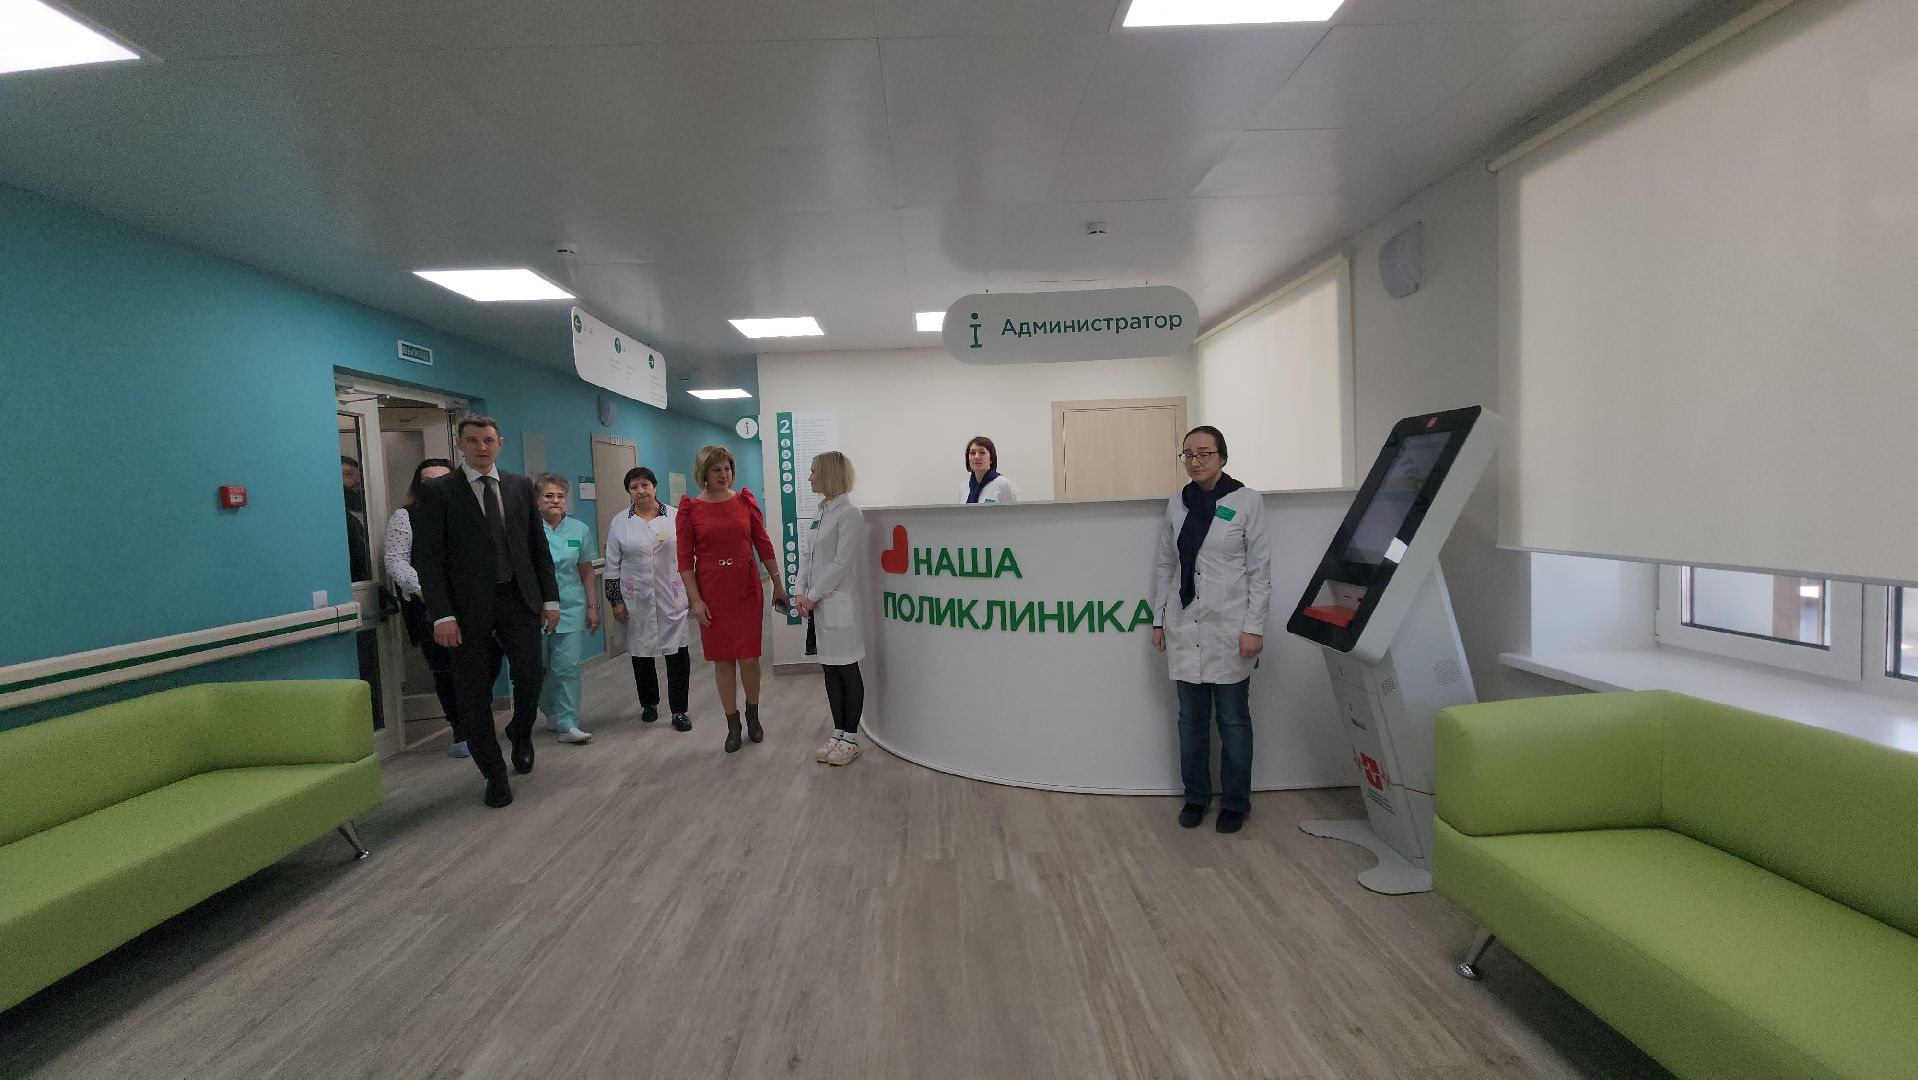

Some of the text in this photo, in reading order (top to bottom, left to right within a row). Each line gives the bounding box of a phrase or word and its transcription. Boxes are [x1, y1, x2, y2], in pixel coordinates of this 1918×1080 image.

[1001, 313, 1183, 338] Администратор
[780, 419, 791, 434] 2
[786, 522, 794, 537] 1
[913, 547, 1023, 579] НАША
[883, 591, 1155, 633] ПОЛИКЛИНИКА
